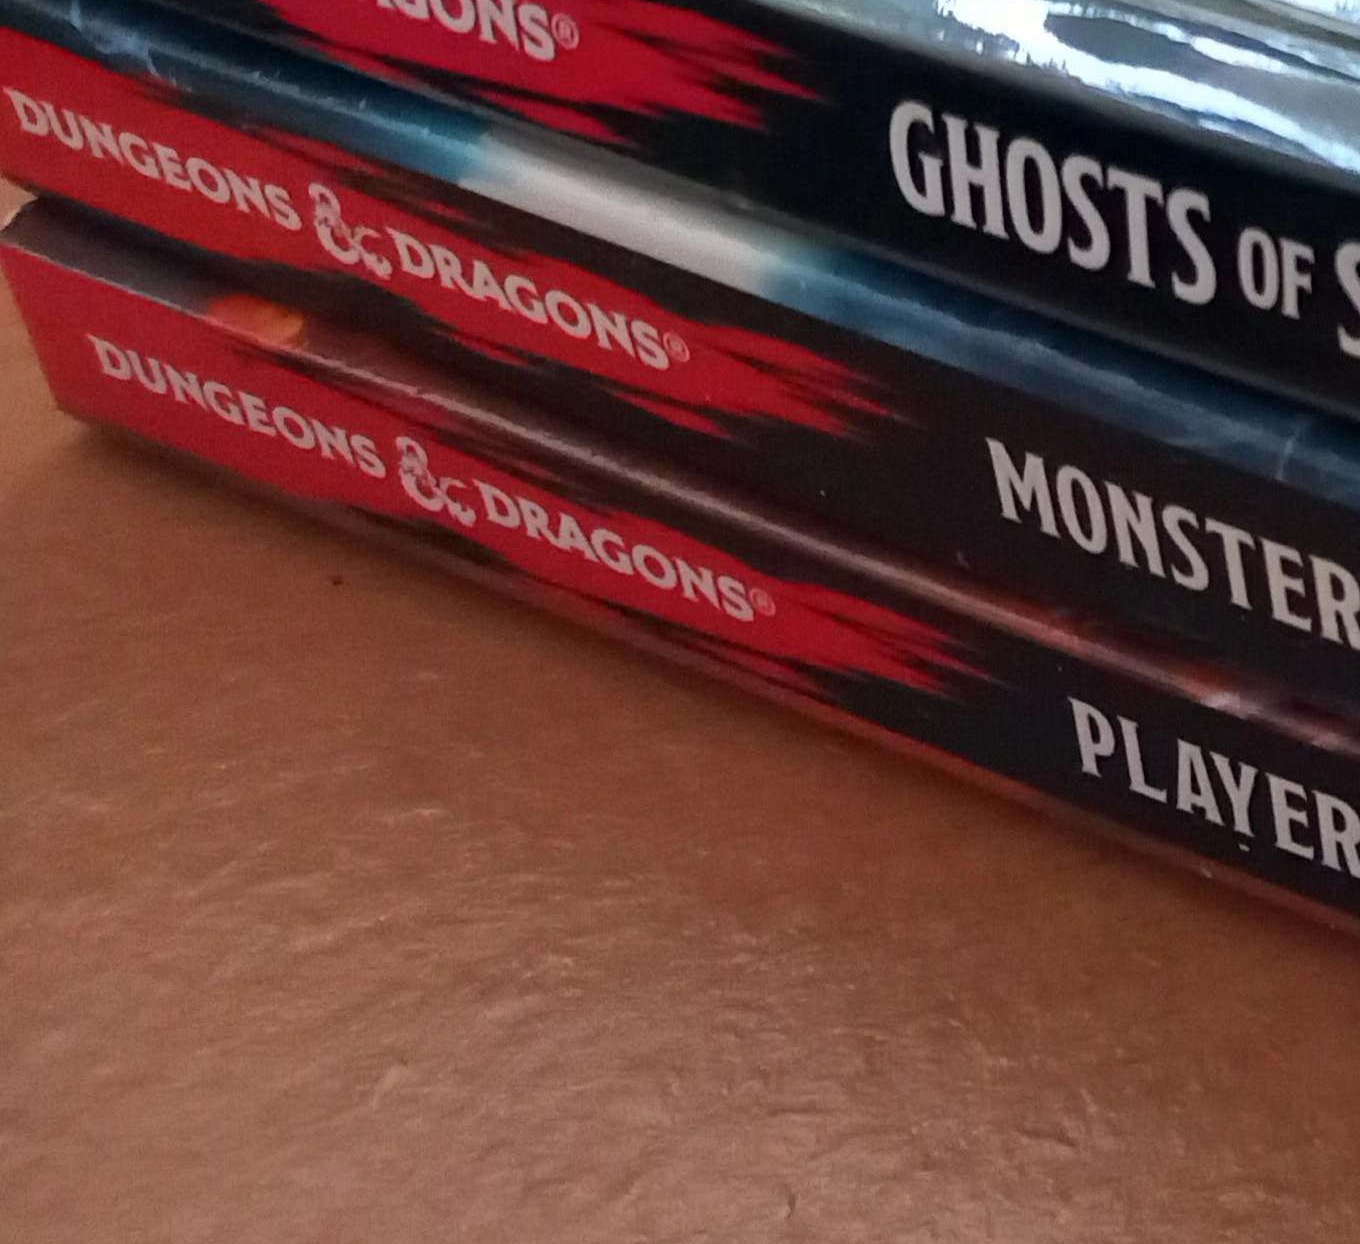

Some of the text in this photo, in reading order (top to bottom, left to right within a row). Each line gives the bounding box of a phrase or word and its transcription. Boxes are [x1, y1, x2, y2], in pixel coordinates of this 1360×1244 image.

[3, 86, 301, 232] DUNGEONS
[888, 99, 1217, 306] GHOSTS
[1238, 227, 1314, 318] OF
[88, 333, 386, 480] DUNGEONS
